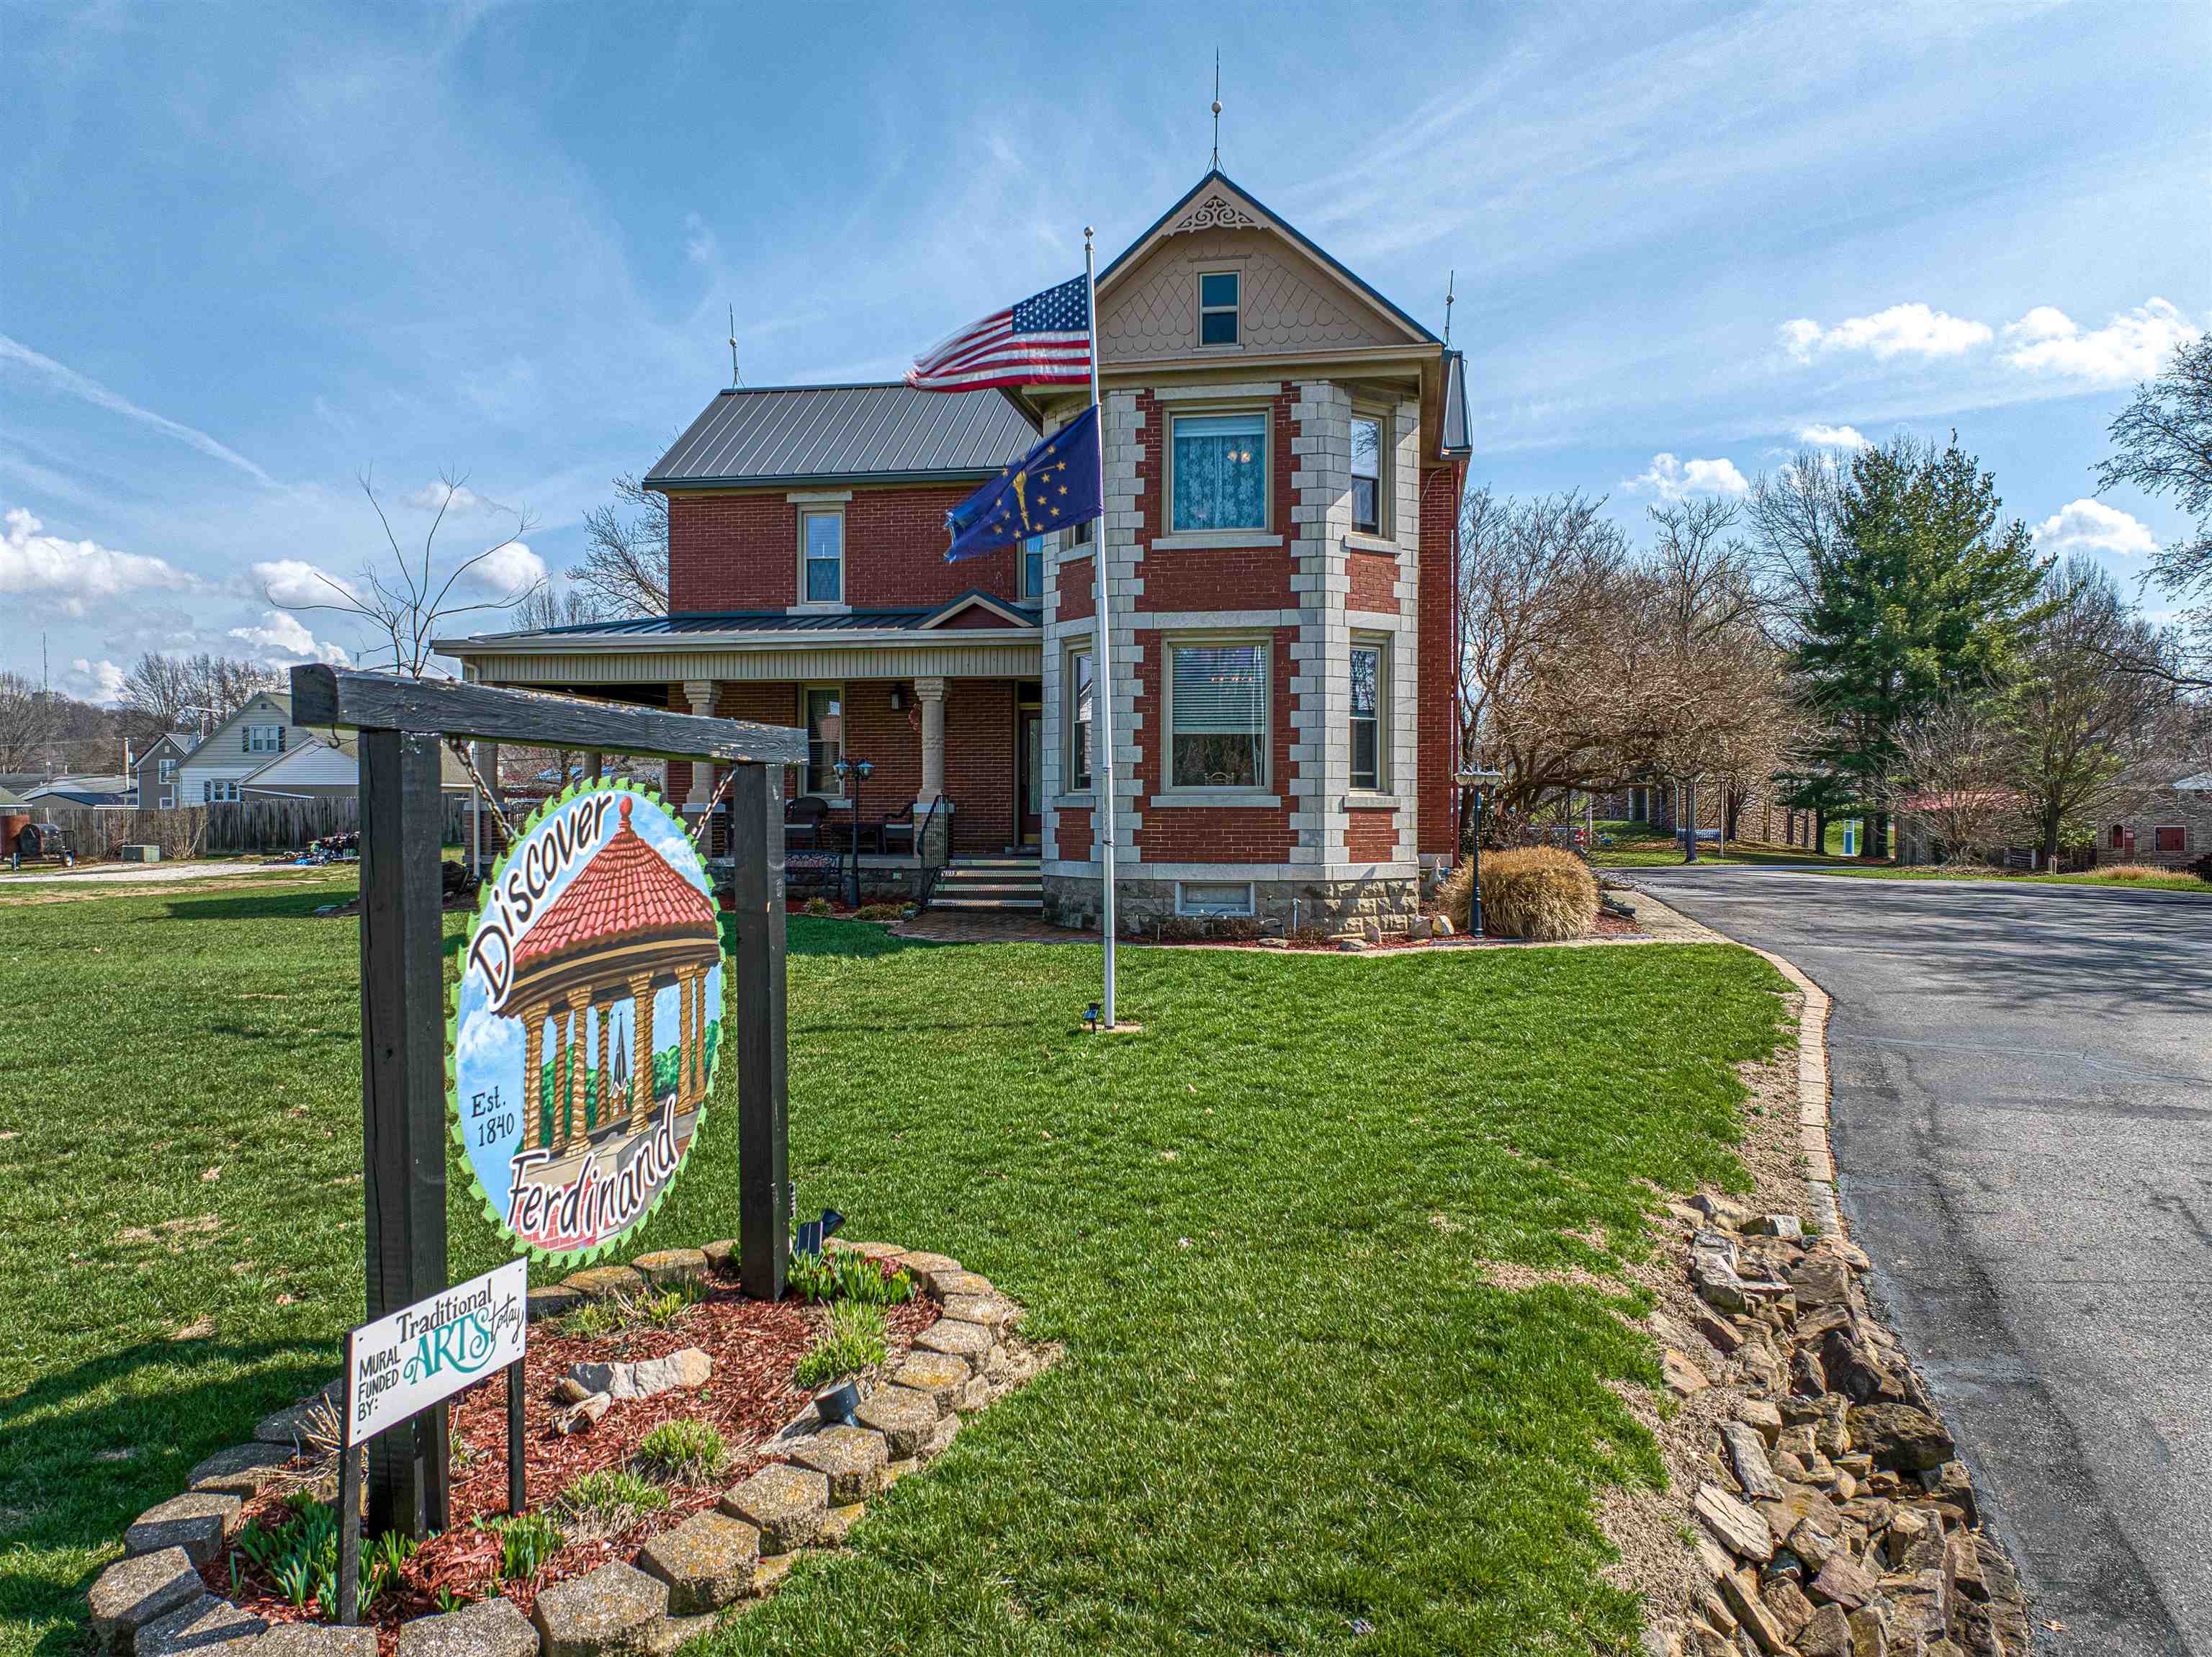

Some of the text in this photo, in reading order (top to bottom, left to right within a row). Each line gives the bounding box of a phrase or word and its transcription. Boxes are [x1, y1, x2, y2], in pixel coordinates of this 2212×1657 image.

[469, 795, 612, 1003] Discover
[472, 1085, 506, 1118] Est.
[478, 1112, 515, 1147] 1840
[507, 1095, 677, 1234] Ferdinand
[397, 1278, 493, 1344] Traditional
[488, 1293, 524, 1344] today
[359, 1345, 401, 1381] MURAL
[403, 1307, 496, 1386] ARTS
[358, 1368, 399, 1403] FUNDED
[358, 1398, 379, 1422] BY:
